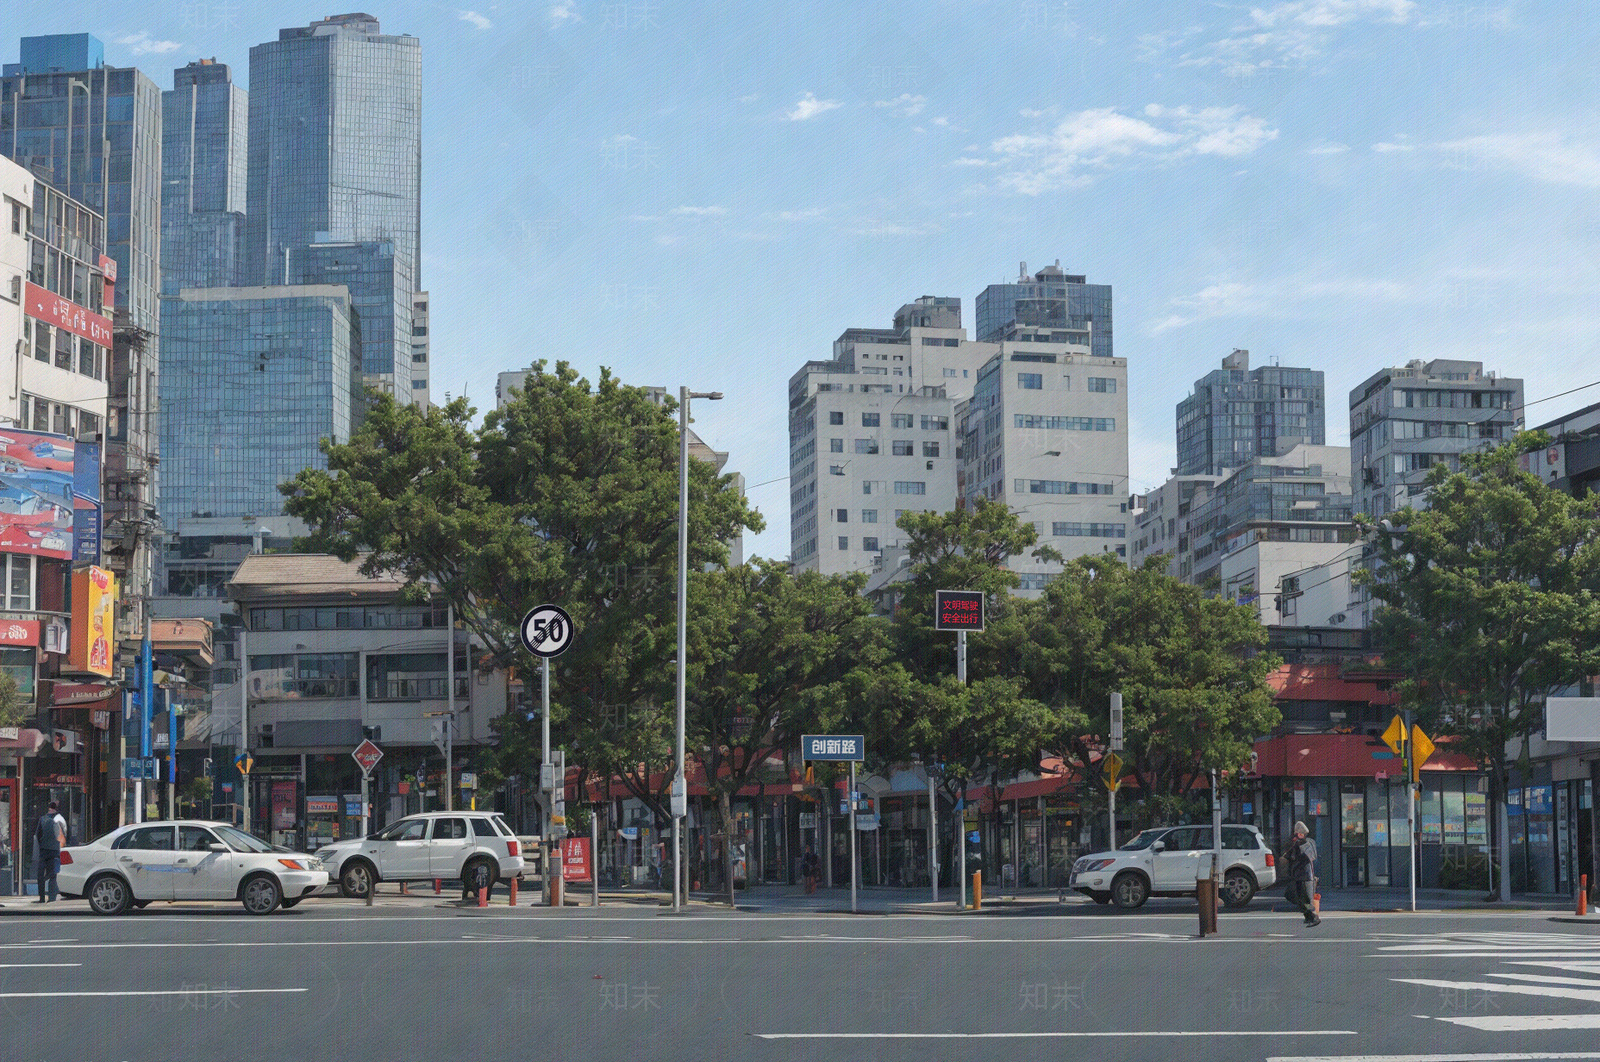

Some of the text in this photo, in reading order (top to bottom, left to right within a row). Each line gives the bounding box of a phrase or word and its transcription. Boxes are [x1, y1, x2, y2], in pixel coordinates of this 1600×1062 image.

[943, 600, 979, 612] 文明驾驶
[942, 613, 978, 625] 安全出行
[533, 618, 564, 644] 50
[811, 739, 857, 756] 创新路
